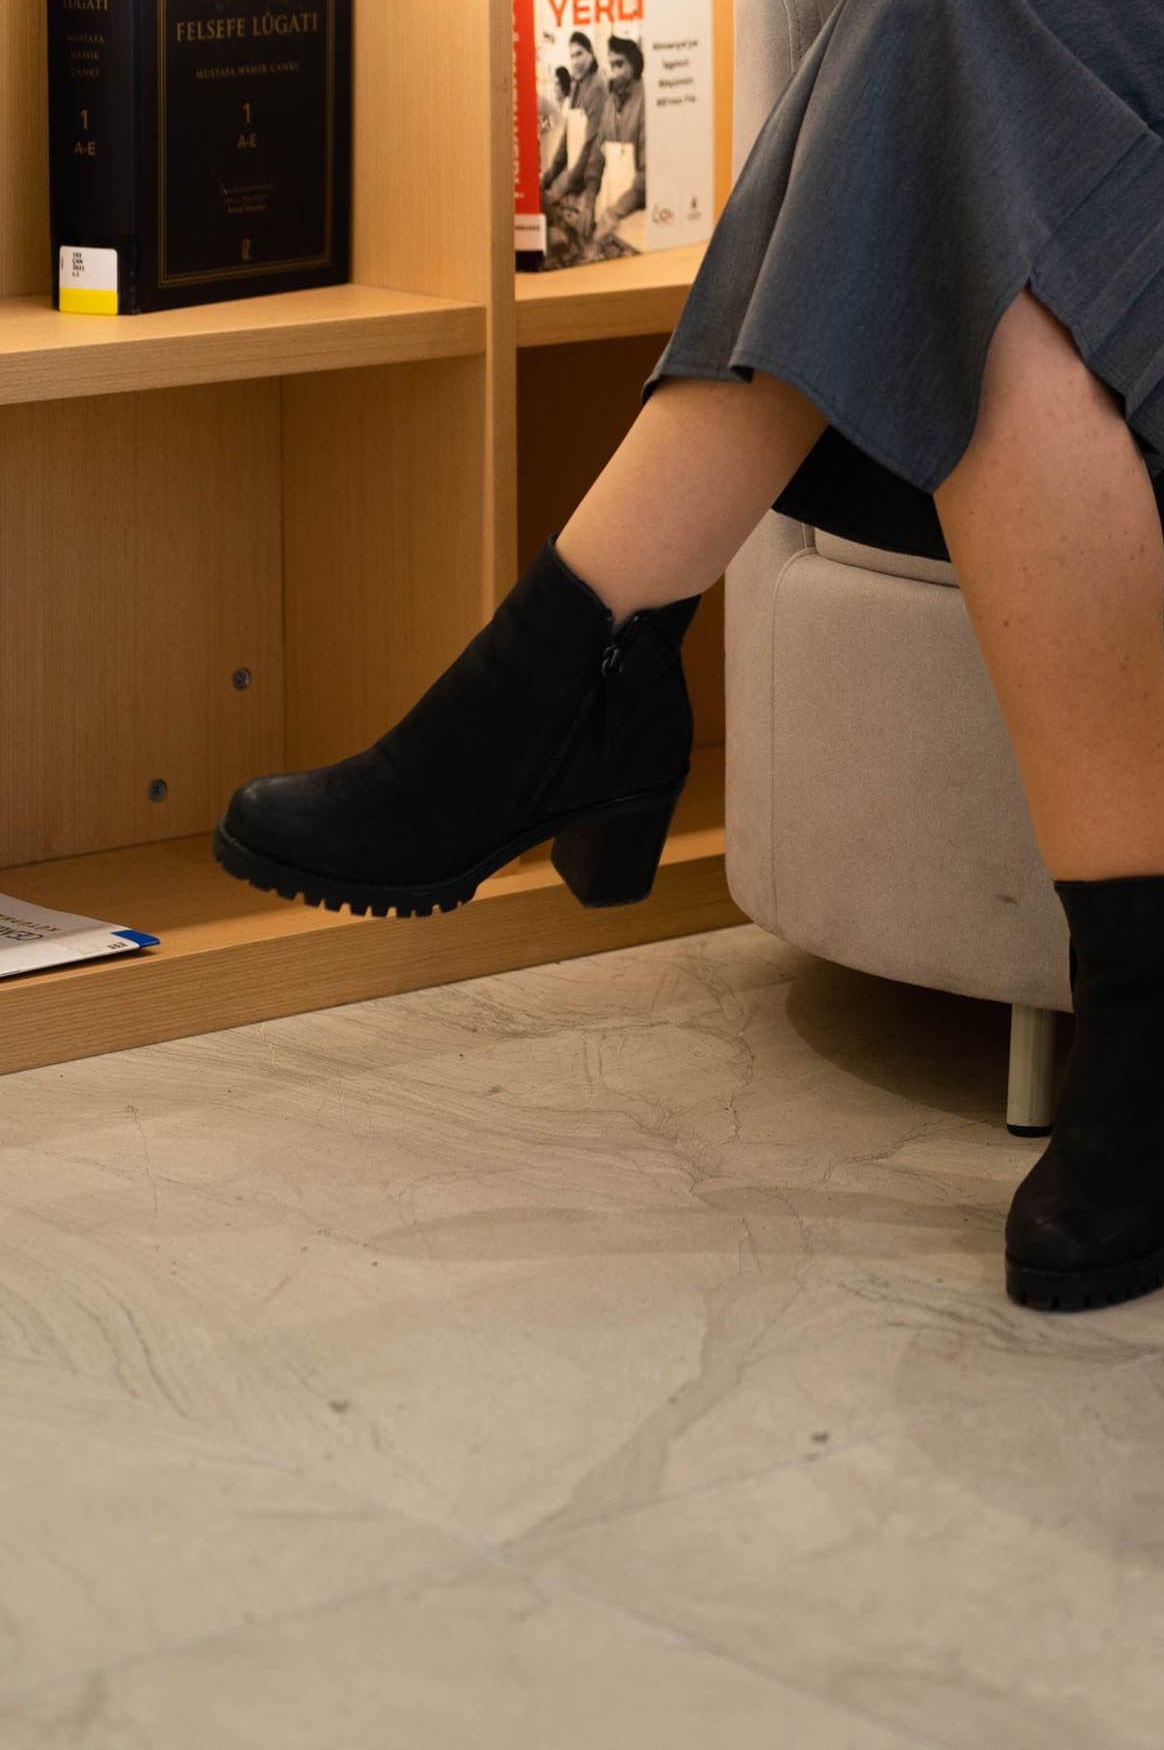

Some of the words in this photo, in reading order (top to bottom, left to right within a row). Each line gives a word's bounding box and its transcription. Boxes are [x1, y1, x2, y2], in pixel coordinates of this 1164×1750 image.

[176, 16, 247, 42] FELSEFE
[79, 108, 88, 130] 1
[242, 101, 251, 123] 1
[74, 141, 96, 157] A-E
[237, 133, 257, 149] A-E
